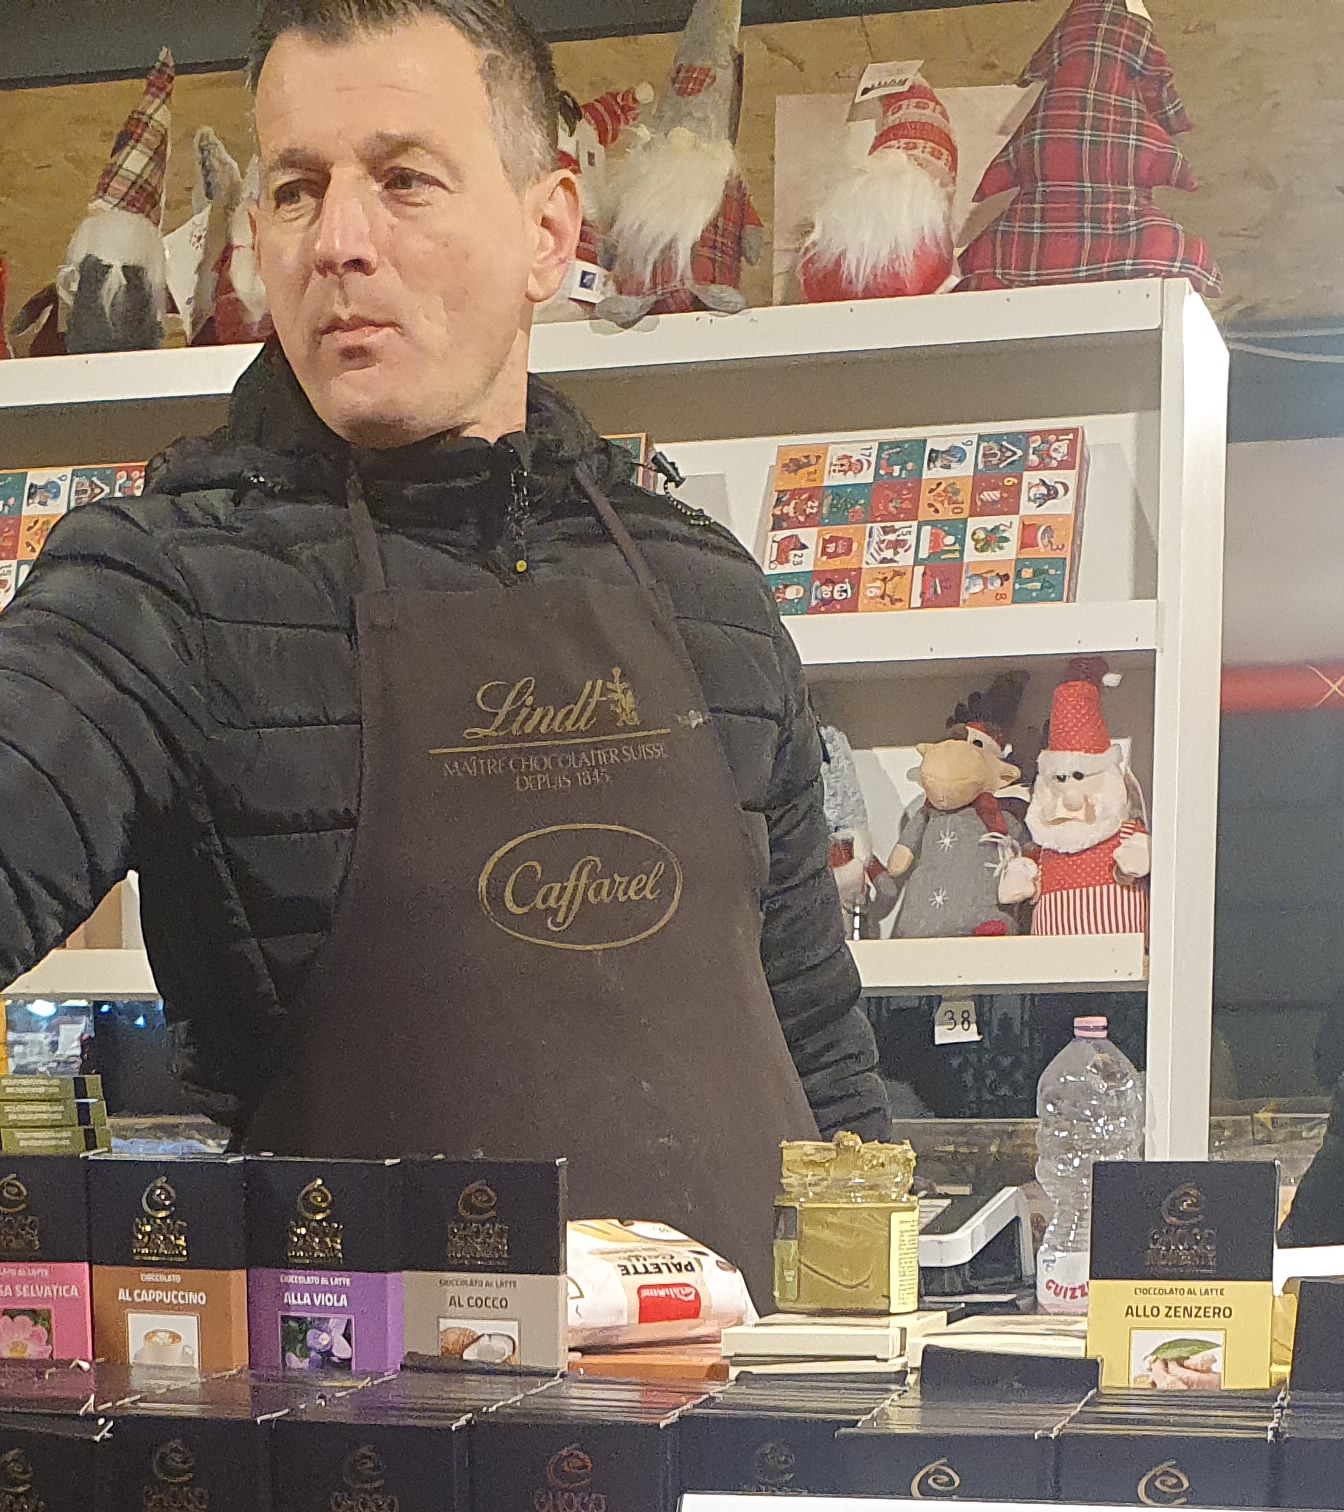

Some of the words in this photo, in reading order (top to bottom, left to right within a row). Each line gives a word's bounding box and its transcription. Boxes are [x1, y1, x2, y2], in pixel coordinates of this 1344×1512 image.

[462, 677, 607, 740] Lindt
[509, 750, 620, 773] CHOCOLATIER
[622, 743, 668, 762] SUISSE
[504, 856, 665, 931] Caffarel
[944, 1010, 970, 1031] 38
[621, 1260, 695, 1275] PALETTE
[118, 1289, 131, 1301] AL
[134, 1290, 206, 1306] CAPPUCCINO
[1045, 1279, 1089, 1299] GUIZZ
[1134, 1287, 1185, 1296] CIOCCOLATO
[1187, 1287, 1197, 1296] AL
[1199, 1288, 1225, 1296] LATTE
[284, 1292, 309, 1306] ALLA
[313, 1293, 347, 1307] VIOLA
[449, 1295, 463, 1308] AL
[467, 1295, 508, 1309] COCCO
[1125, 1305, 1160, 1318] ALLO
[1165, 1306, 1232, 1319] ZENZERO
